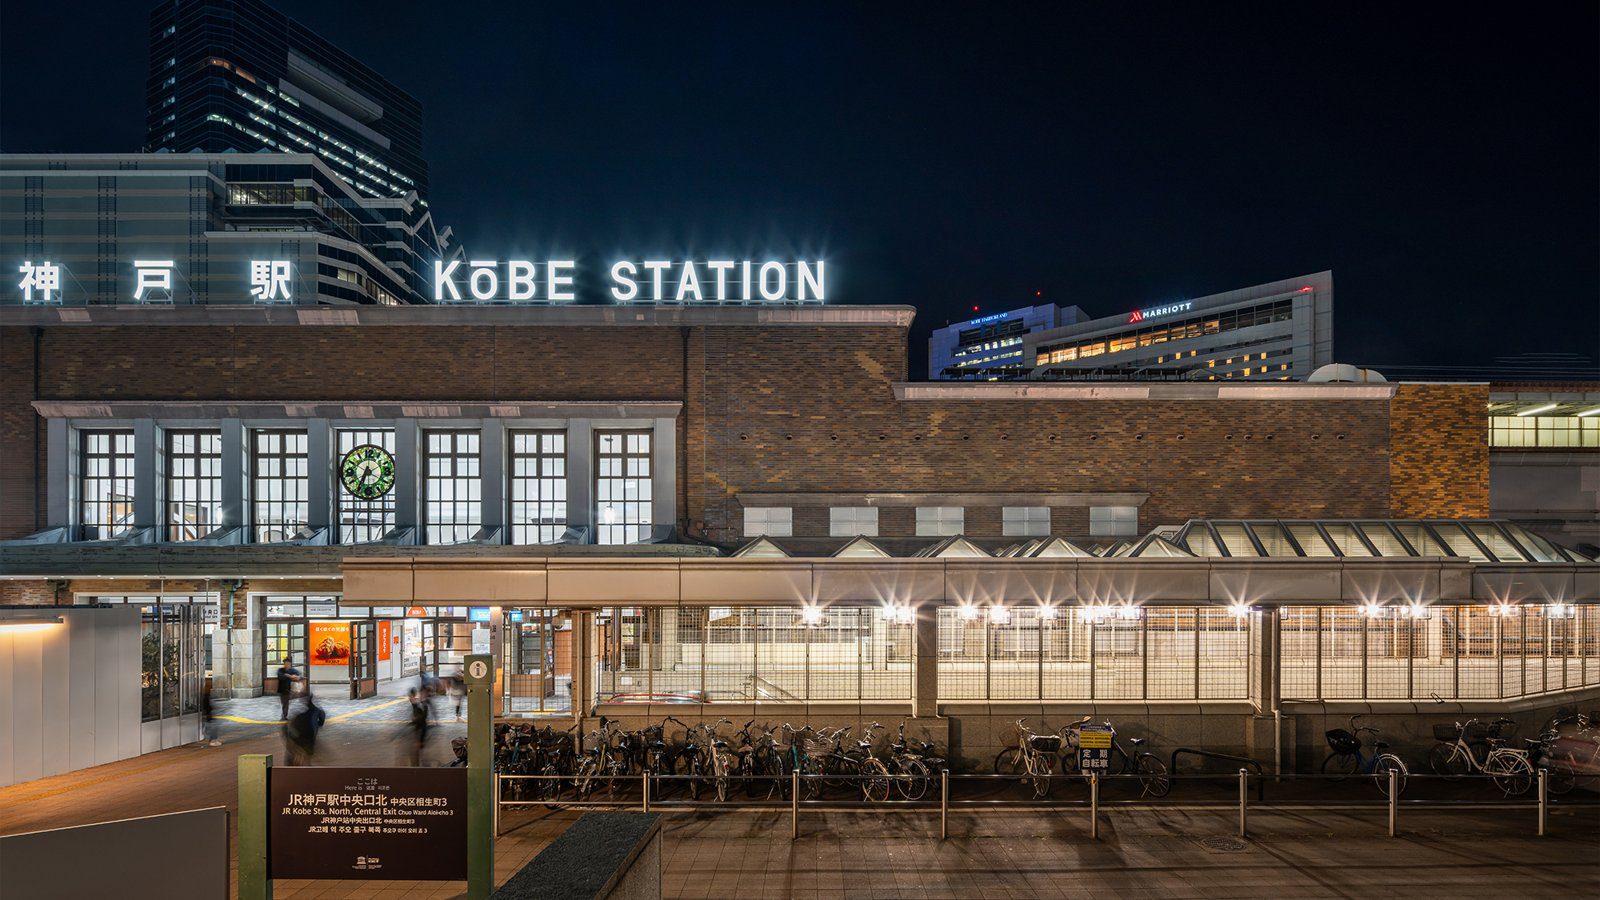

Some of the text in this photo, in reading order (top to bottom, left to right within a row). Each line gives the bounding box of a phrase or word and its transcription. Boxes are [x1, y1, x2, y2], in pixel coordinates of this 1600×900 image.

[19, 260, 292, 300] 神戸駅
[611, 260, 826, 300] STATION
[1142, 302, 1192, 319] MARRIOTT
[365, 449, 374, 458] 12
[346, 468, 355, 477] 9
[1082, 759, 1108, 768] 自転車
[288, 793, 447, 806] JR神戸駅中央口北 中央区相生町3
[282, 807, 291, 815] JR
[292, 807, 311, 815] Kobe
[313, 807, 327, 815] Sta.
[328, 807, 353, 816] North,
[354, 807, 381, 815] Central
[383, 807, 397, 815] Exit
